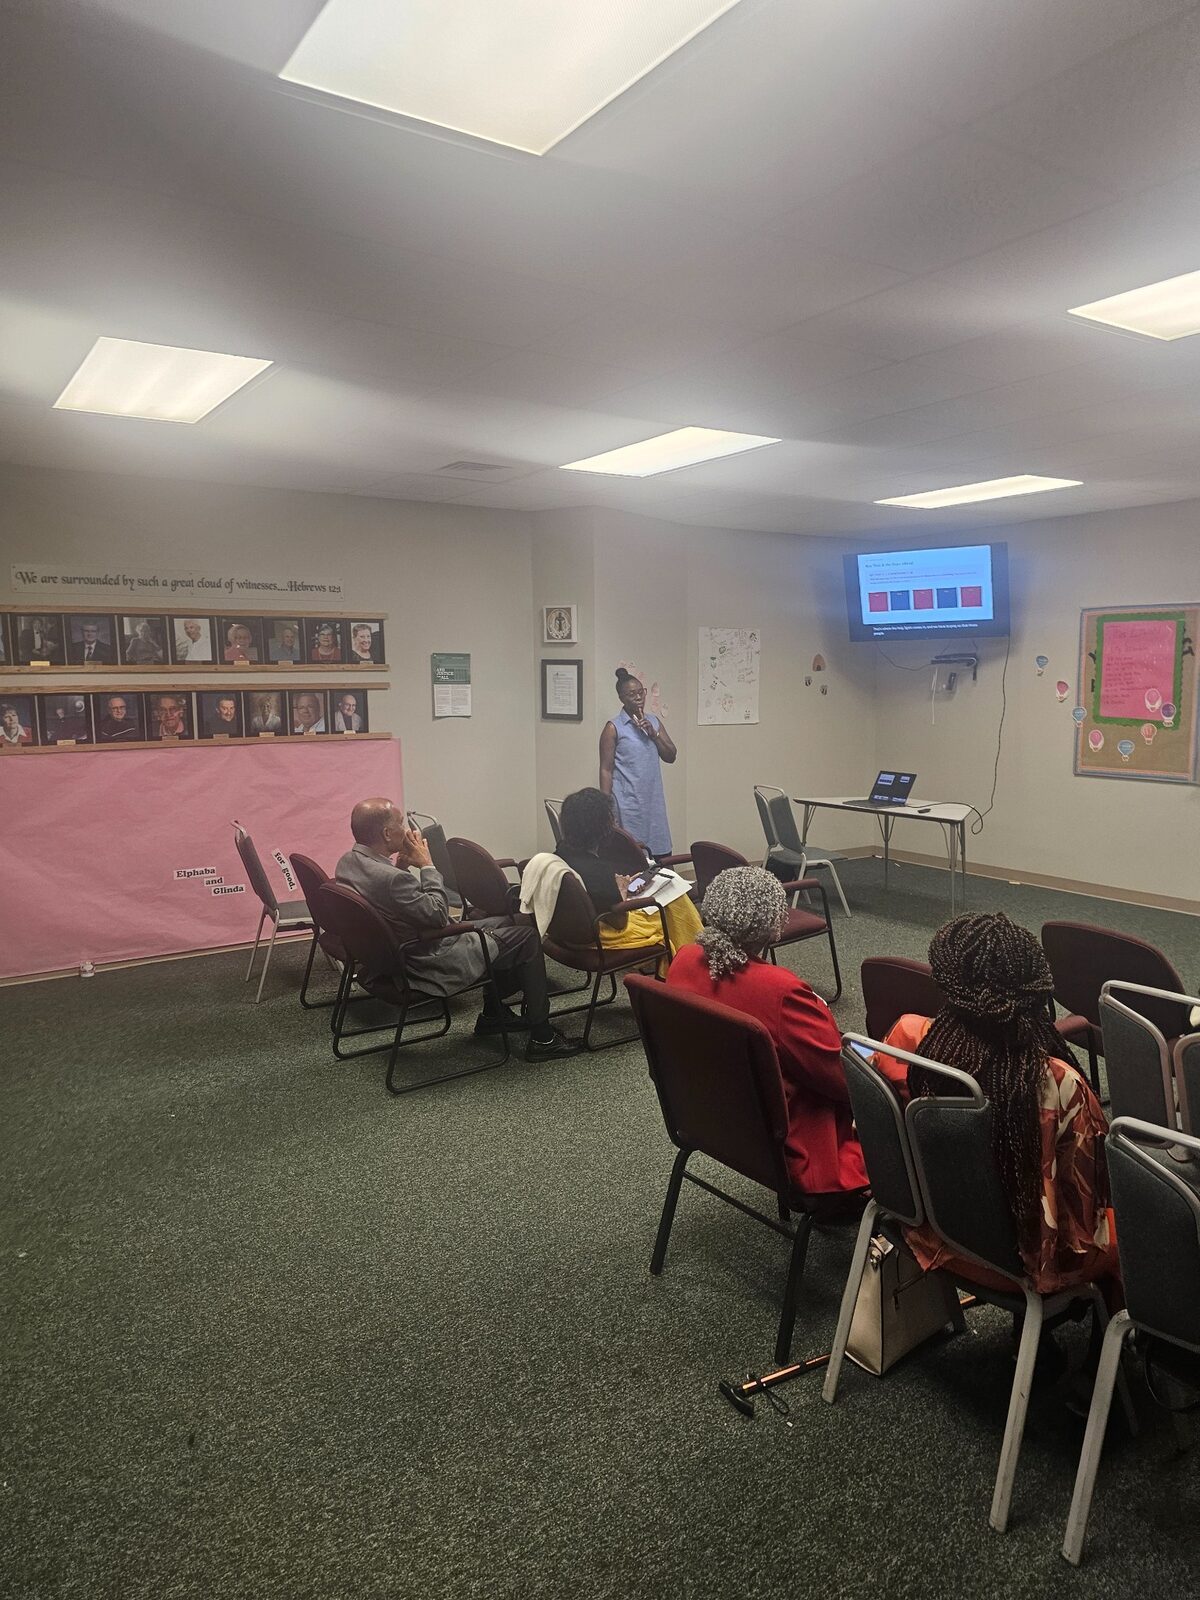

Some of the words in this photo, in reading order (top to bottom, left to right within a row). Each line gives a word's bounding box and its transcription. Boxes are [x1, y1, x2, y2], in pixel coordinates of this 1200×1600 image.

[15, 571, 38, 585] We
[41, 574, 58, 584] are
[61, 574, 120, 586] surrounded
[122, 575, 135, 591] by
[137, 575, 159, 587] such
[162, 579, 168, 587] a
[170, 578, 194, 592] great
[197, 577, 222, 589] cloud
[224, 578, 235, 594] of
[328, 585, 341, 593] 12:1
[176, 867, 216, 878] Elphaba
[274, 852, 286, 865] for
[282, 867, 296, 890] good.
[205, 877, 223, 885] and
[213, 885, 244, 895] Glinda
